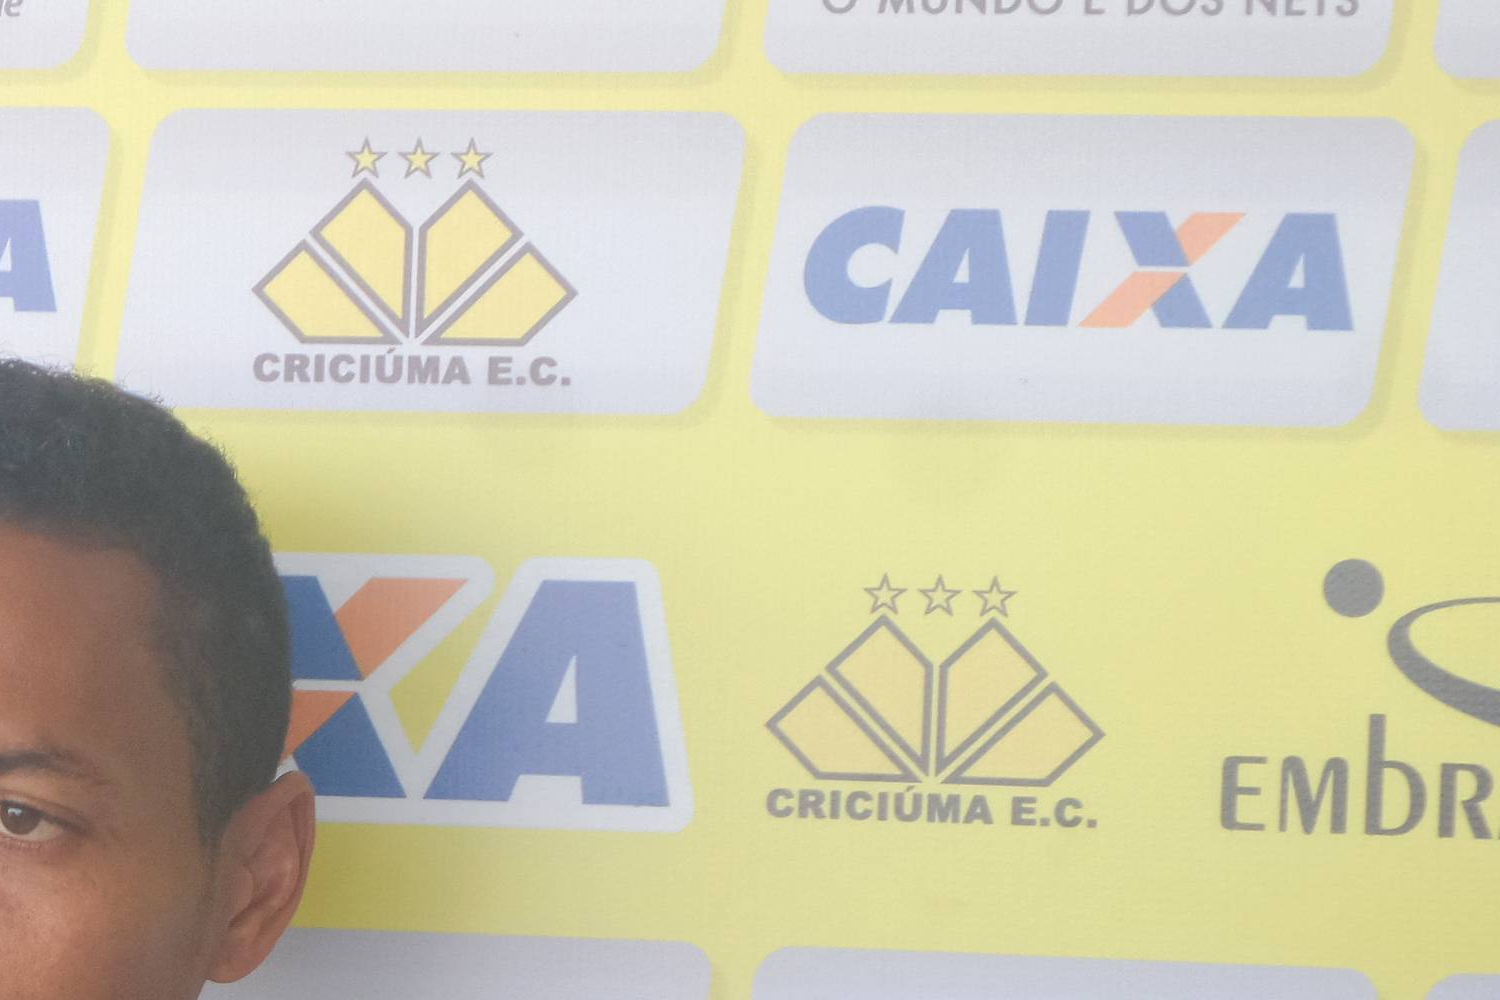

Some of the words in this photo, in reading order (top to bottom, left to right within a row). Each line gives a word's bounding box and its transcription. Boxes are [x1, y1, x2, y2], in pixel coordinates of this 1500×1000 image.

[803, 206, 1354, 331] CAIXA
[253, 347, 471, 384] CRICIÚMA
[487, 356, 571, 386] E.C.
[766, 787, 993, 825] CRICIÚMA
[1011, 797, 1097, 828] E.C.
